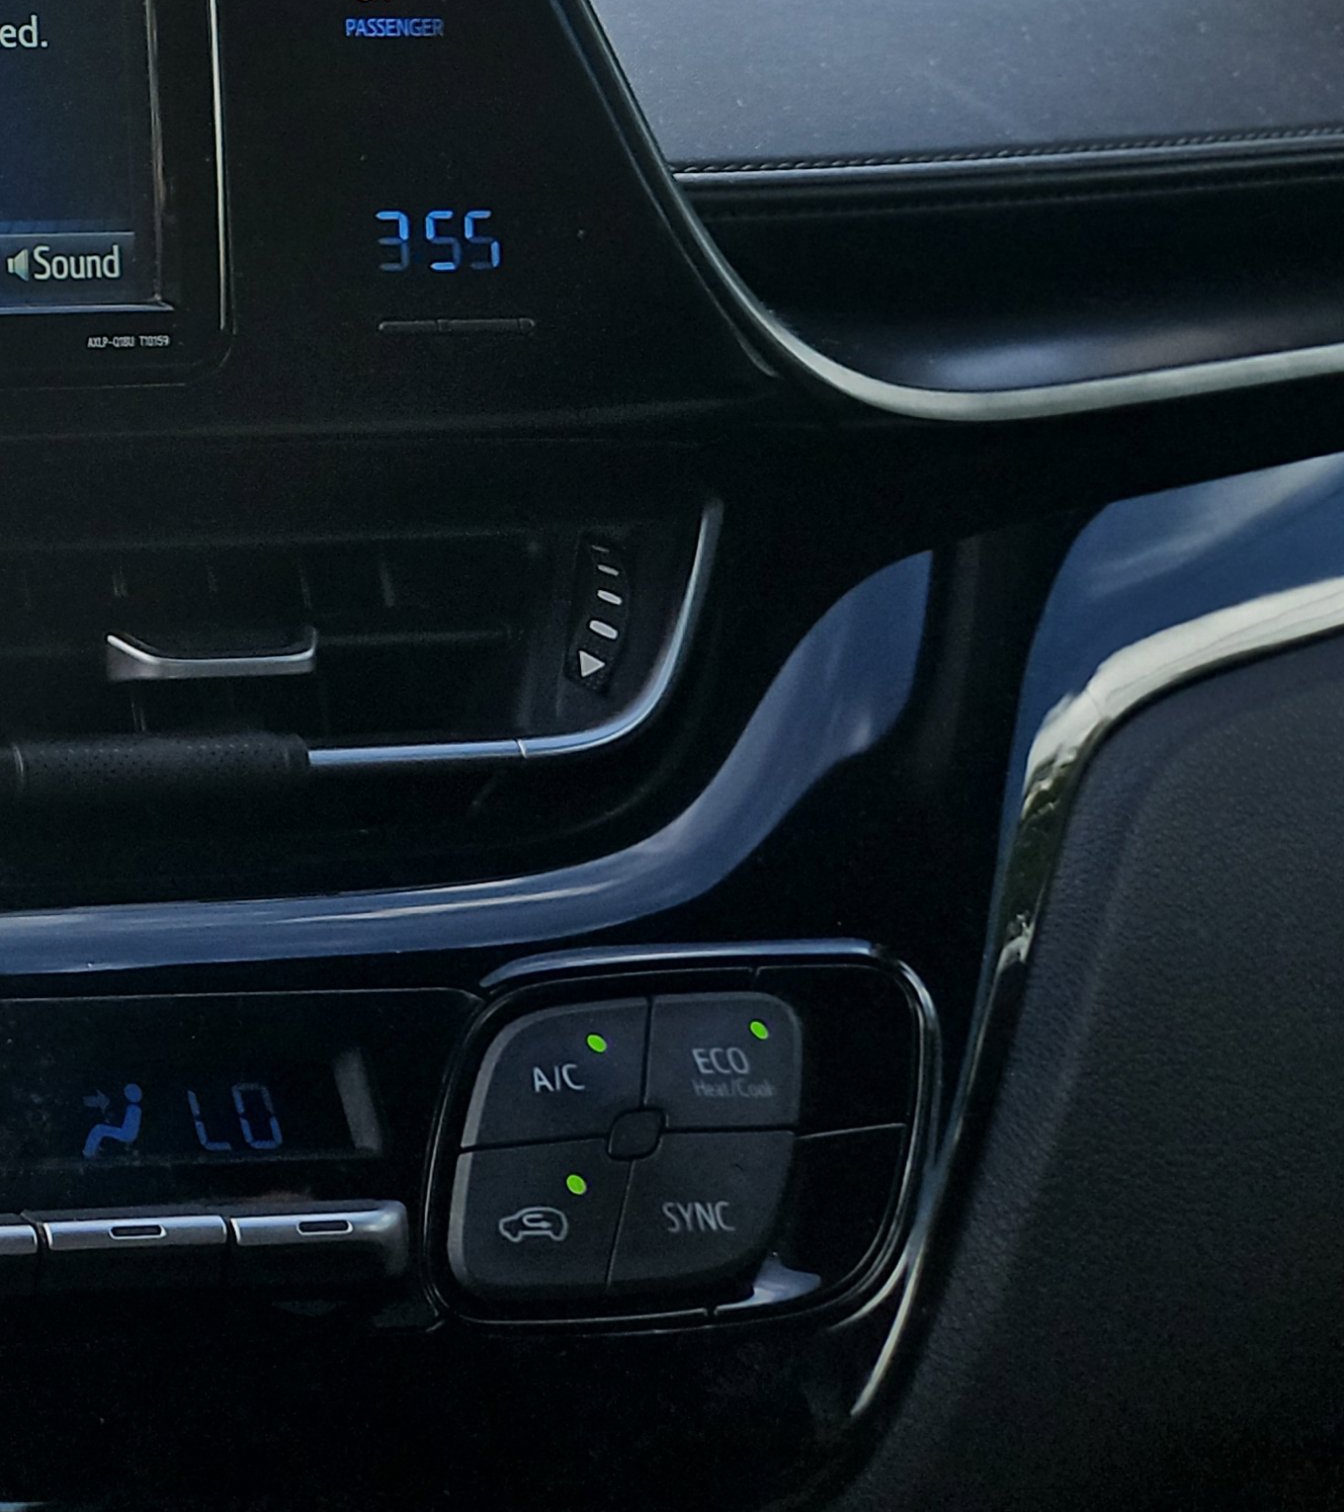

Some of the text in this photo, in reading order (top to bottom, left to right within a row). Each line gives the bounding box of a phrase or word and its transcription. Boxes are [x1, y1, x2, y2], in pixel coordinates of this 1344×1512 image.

[345, 17, 444, 38] PASSENGER
[33, 244, 121, 281] Sound
[691, 1046, 750, 1076] ECO
[531, 1063, 585, 1093] A/C
[661, 1200, 736, 1233] SYNC
